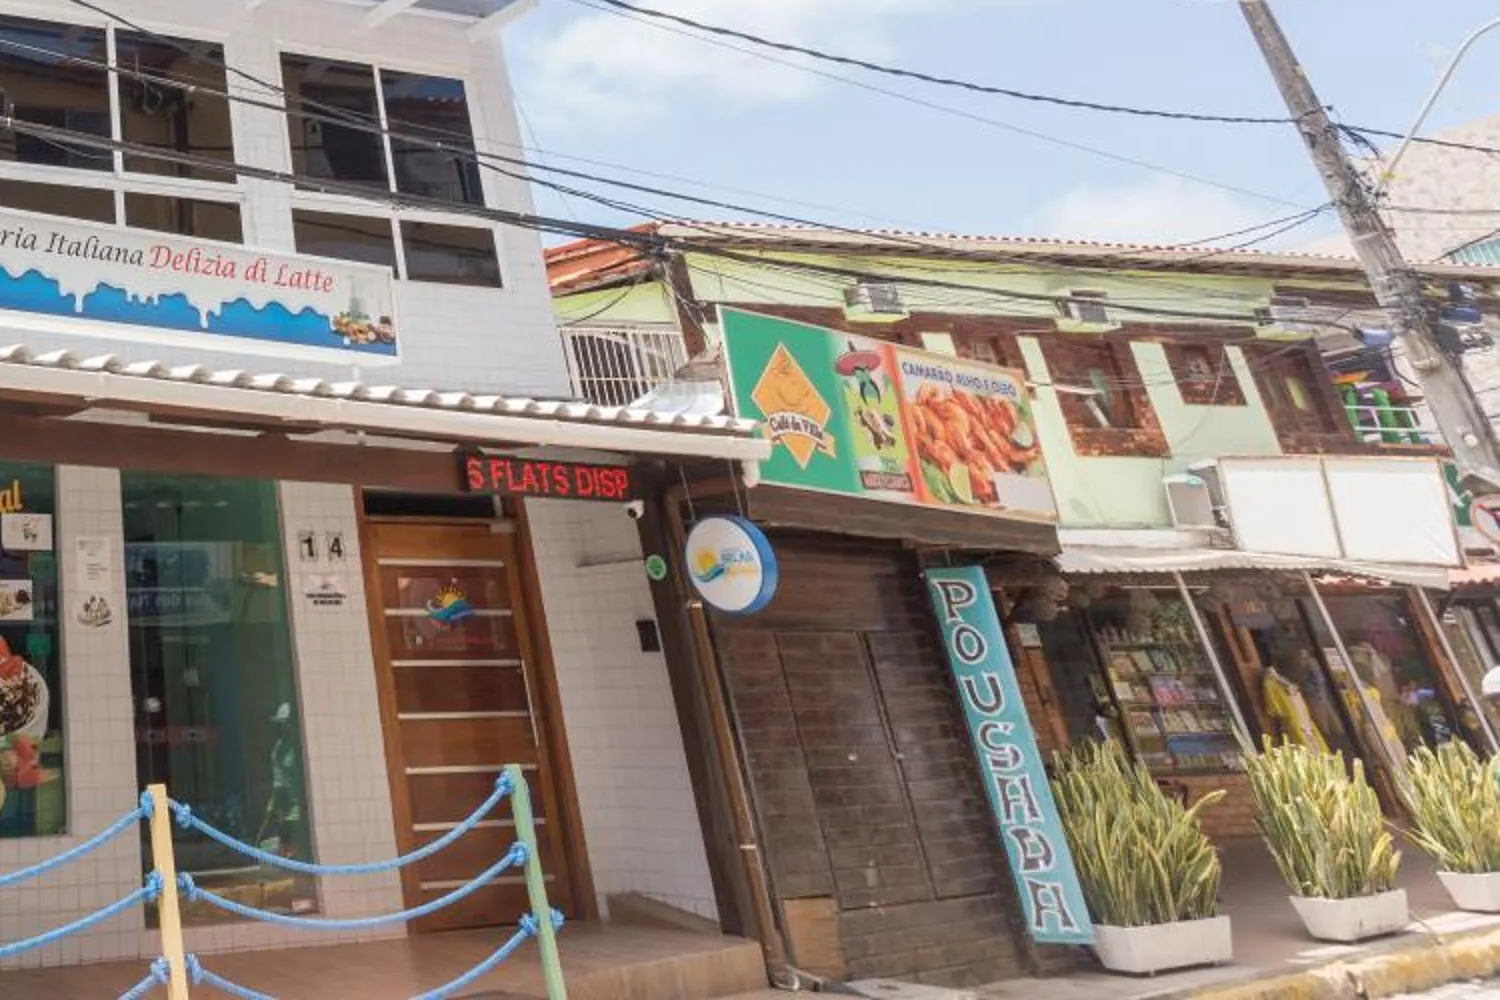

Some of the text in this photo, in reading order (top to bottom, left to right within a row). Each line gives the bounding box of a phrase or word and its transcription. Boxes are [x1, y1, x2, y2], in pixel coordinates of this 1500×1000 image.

[44, 231, 146, 267] Italiana
[150, 245, 236, 279] Delizia
[244, 257, 268, 283] di
[273, 264, 334, 293] Latte
[466, 458, 630, 499] S FLATS DISP
[930, 577, 1084, 937] POUSADA
